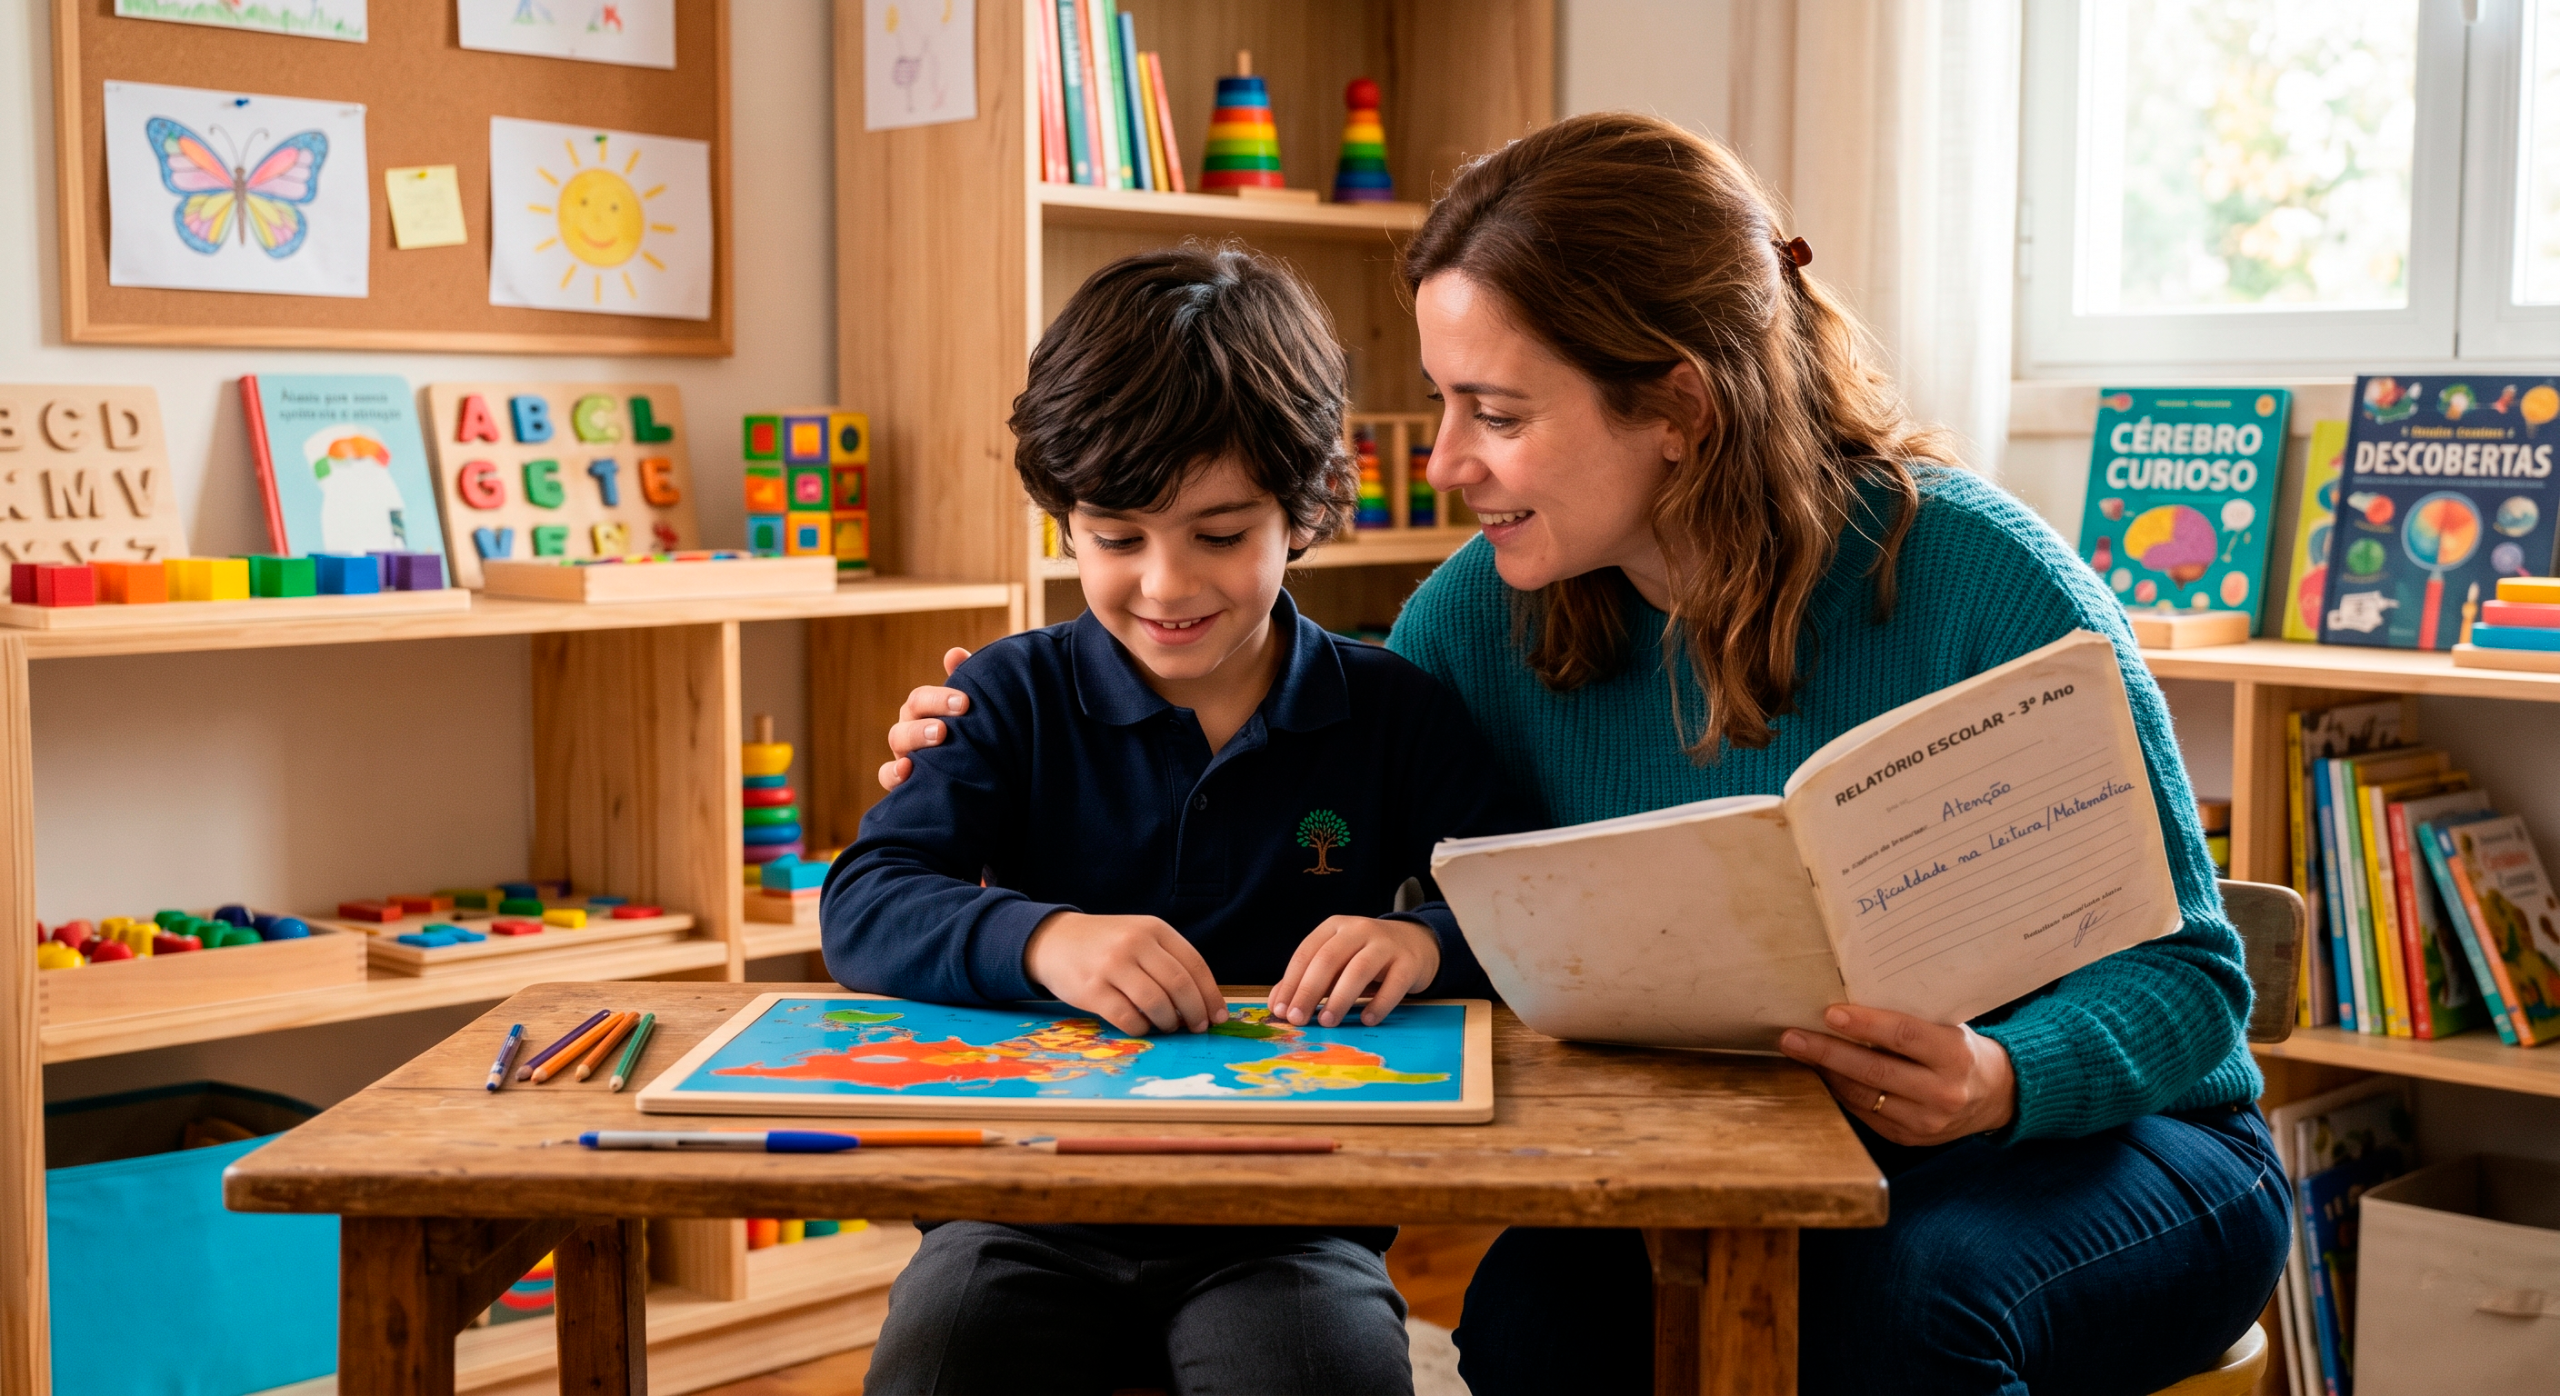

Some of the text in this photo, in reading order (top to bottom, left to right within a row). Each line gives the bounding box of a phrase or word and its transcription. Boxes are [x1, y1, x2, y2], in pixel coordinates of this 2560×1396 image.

[2109, 415, 2263, 456] CÉREBRO
[2106, 457, 2258, 492] CURIOSO
[2353, 441, 2553, 479] DESCOBERTAS
[1835, 750, 1924, 806] RELATÓRIO
[1927, 712, 2005, 757] ESCOLAR
[2041, 684, 2075, 707] Ano
[1943, 781, 2011, 821] Atenção
[1857, 862, 1949, 915] Dificuldade
[1958, 850, 1981, 864] na
